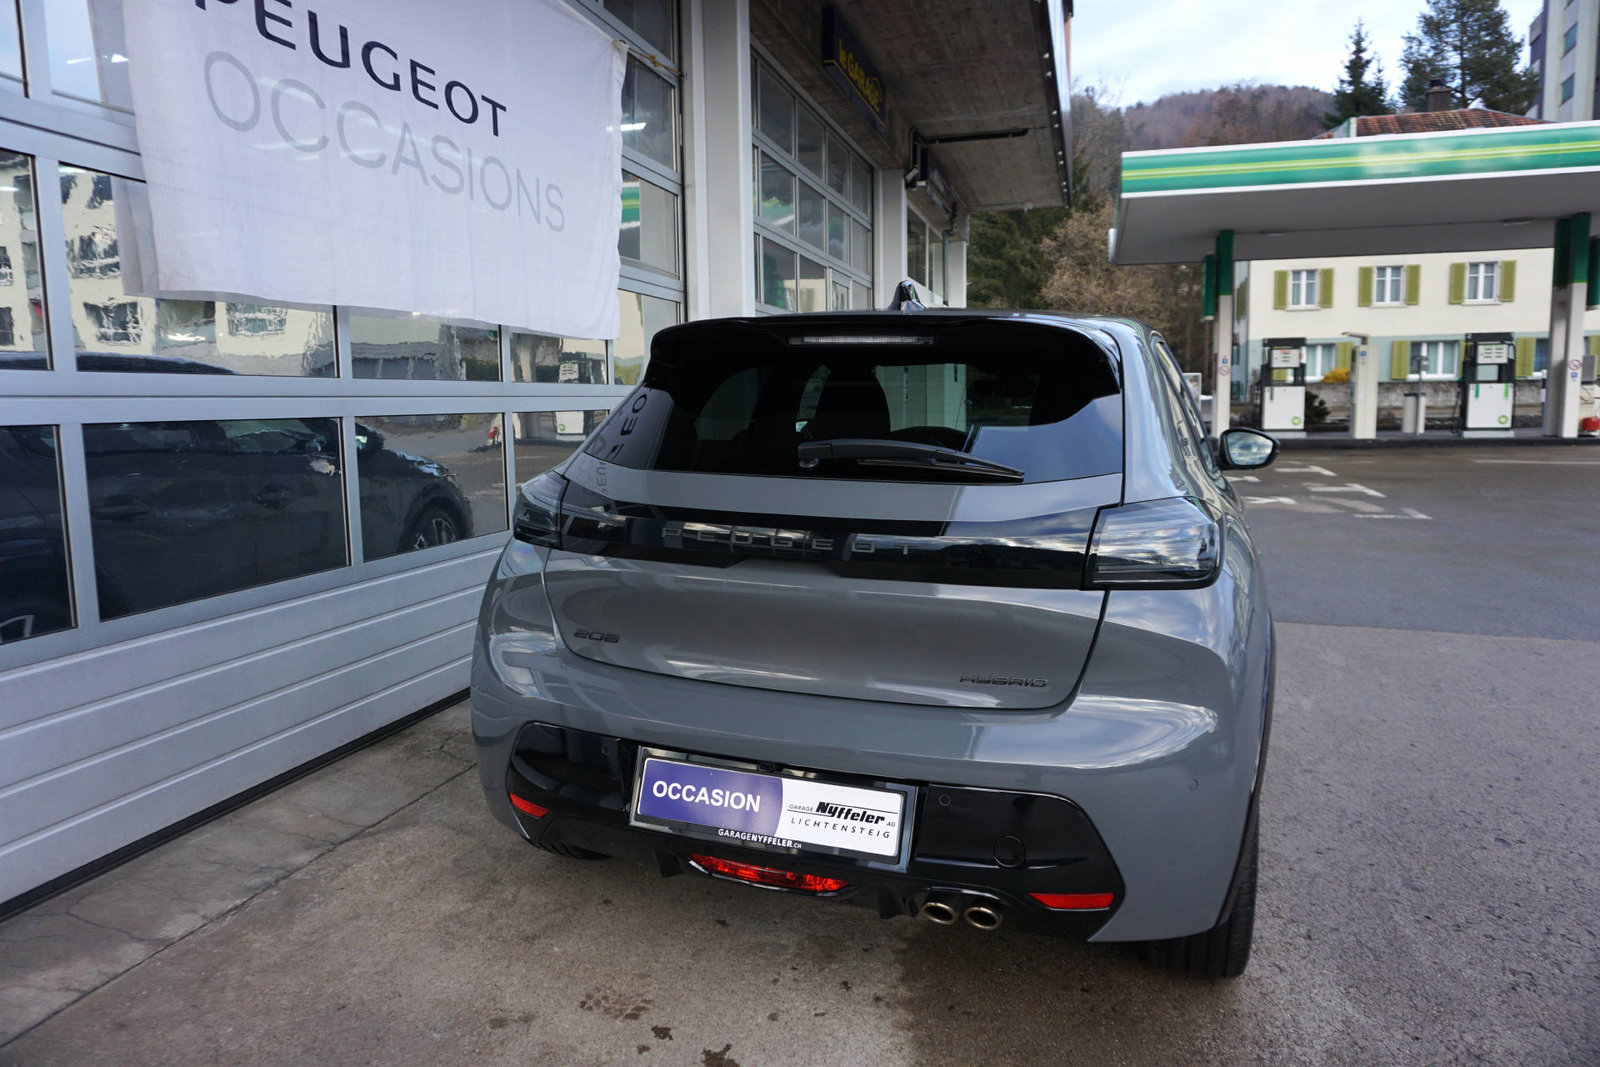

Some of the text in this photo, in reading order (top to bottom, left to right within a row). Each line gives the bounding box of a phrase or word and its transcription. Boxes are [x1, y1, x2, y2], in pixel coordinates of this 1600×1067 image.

[195, 0, 506, 137] EUGEOT
[203, 50, 566, 233] OCCASIONS
[661, 526, 918, 556] PEUGEOT
[652, 780, 761, 813] OCCASION
[788, 803, 815, 813] GARAGE
[815, 801, 886, 825] Nyffeler
[790, 817, 891, 840] LICHTENSTEIG
